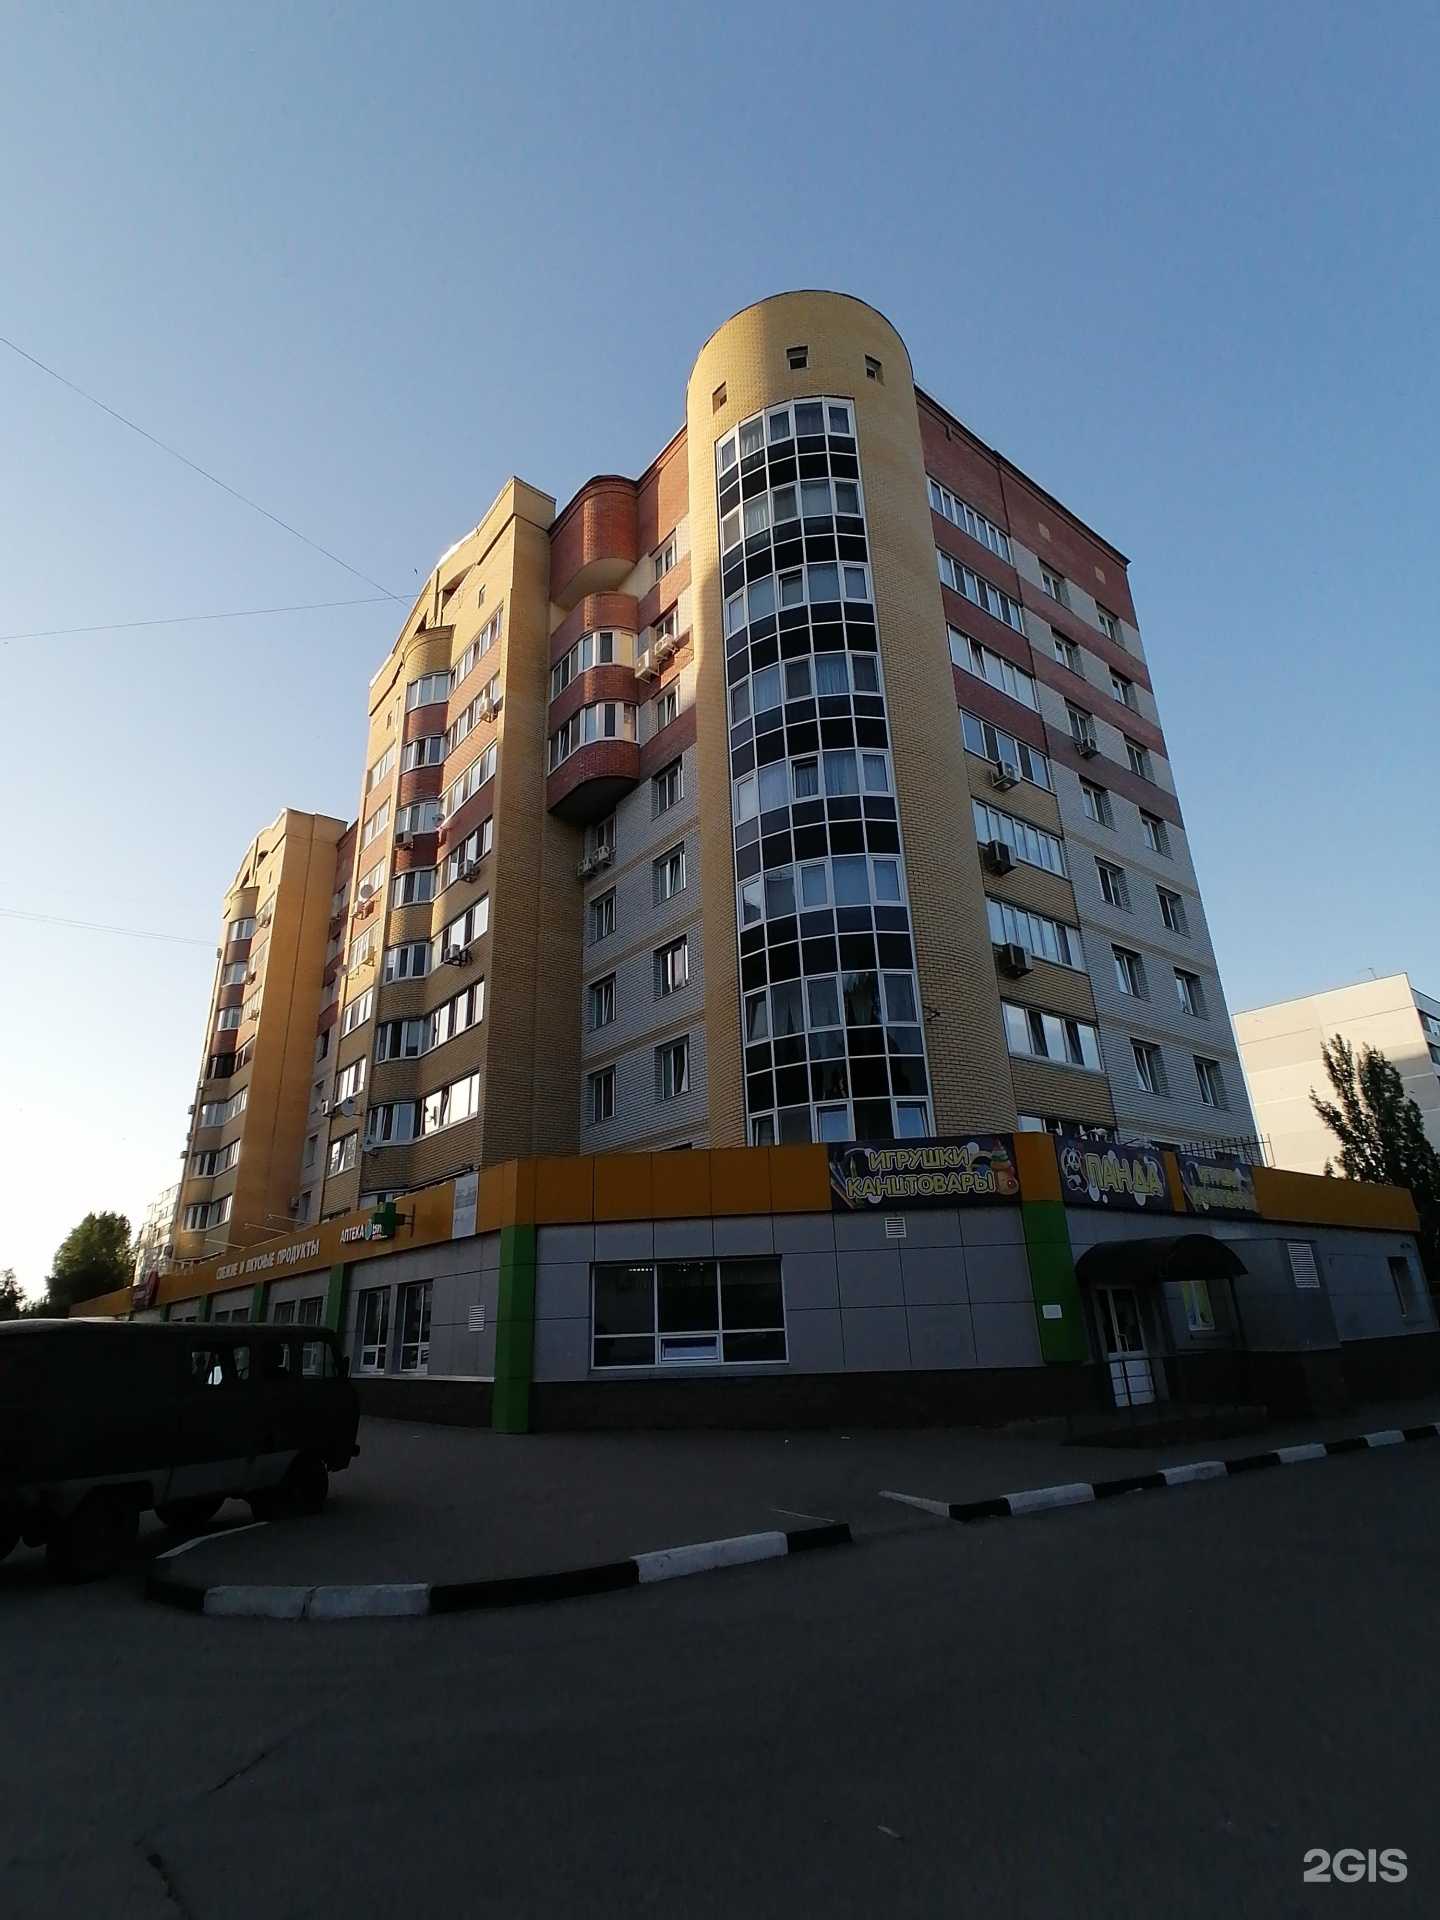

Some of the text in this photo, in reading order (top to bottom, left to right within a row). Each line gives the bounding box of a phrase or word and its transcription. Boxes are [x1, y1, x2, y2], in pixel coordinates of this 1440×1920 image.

[869, 1146, 970, 1171] ИГРУШКИ
[846, 1172, 995, 1198] КАНЦТОВАРЫ
[1085, 1152, 1164, 1197] ПАНДА
[340, 1224, 364, 1243] АПТЕКА
[277, 1239, 320, 1265] ПРОДУКТЫ
